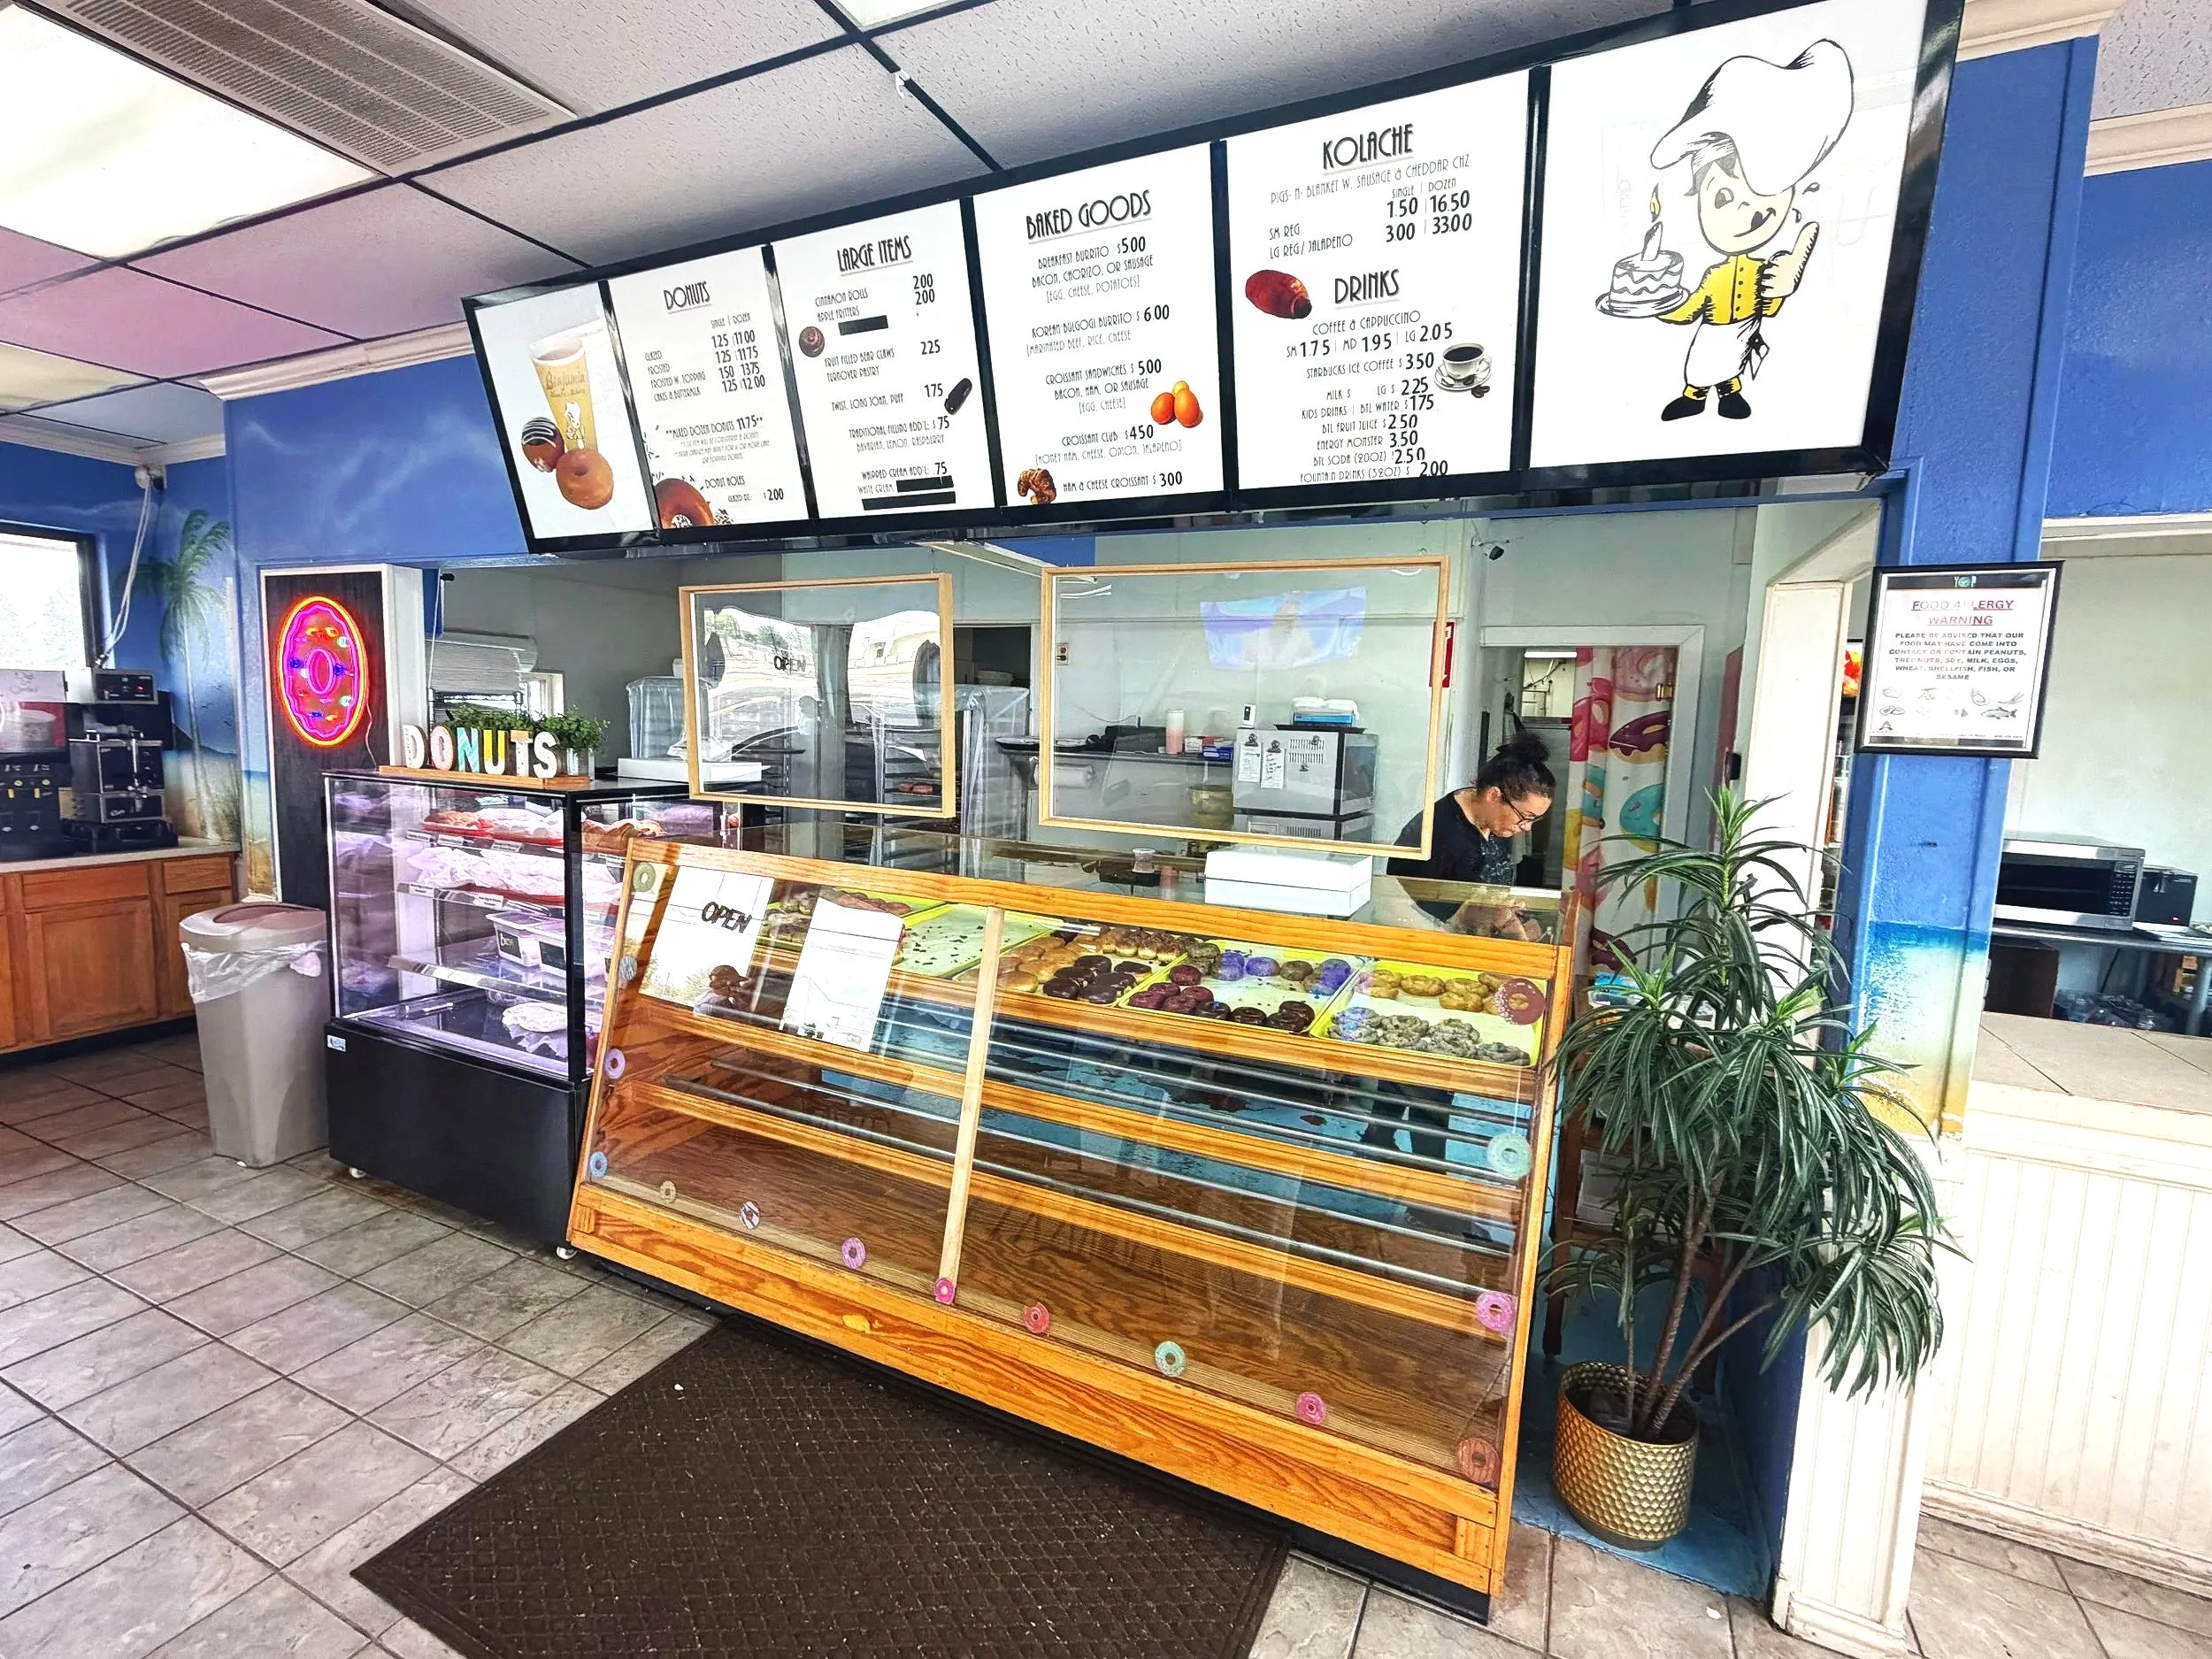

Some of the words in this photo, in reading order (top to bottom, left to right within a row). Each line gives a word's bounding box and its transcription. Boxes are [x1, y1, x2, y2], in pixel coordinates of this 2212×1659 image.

[1323, 123, 1413, 170] KOLACHE
[1306, 179, 1338, 197] BLANKET
[1356, 169, 1391, 188] SAUSAGE
[1394, 167, 1401, 180] &
[1405, 158, 1448, 177] CHEDDAR
[1452, 153, 1469, 168] CHZ
[1392, 185, 1414, 198] SINGLE
[1428, 177, 1455, 192] DOZEN
[1025, 208, 1072, 240] BAKED
[1078, 189, 1151, 227] GOODS
[1269, 227, 1280, 240] SM
[1284, 223, 1299, 237] REG
[1386, 196, 1417, 218] 1.50
[1430, 189, 1470, 212] 16.50
[1270, 246, 1279, 259] LG
[1386, 222, 1415, 242] 3.00
[836, 242, 875, 272] LARGE
[878, 234, 911, 264] ITEMS
[1038, 252, 1071, 269] BREAKFAST
[1075, 245, 1109, 262] BURRITO
[1032, 273, 1060, 288] BACON,
[1063, 265, 1103, 281] CHORIZO,
[1106, 261, 1120, 273] OR
[1124, 254, 1153, 270] SAUSAGE
[663, 280, 710, 311] DONUTS
[848, 288, 868, 301] ROLLS
[1334, 268, 1399, 303] DRINKS
[1032, 324, 1060, 338] KOREAN
[1063, 318, 1095, 333] BULGOGI
[1098, 311, 1132, 327] BURRITO
[1143, 304, 1169, 321] 6.00
[1312, 319, 1345, 335] COFFEE
[1349, 319, 1356, 330] &
[1359, 310, 1420, 329] CAPPUCCINO
[1108, 329, 1131, 342] CHEESE
[1286, 345, 1297, 357] SM
[1300, 339, 1330, 357] 1.75
[1342, 337, 1356, 350] MD
[1362, 332, 1391, 352] 1.95
[1405, 329, 1415, 342] LG
[1419, 321, 1452, 342] 2.05
[876, 347, 895, 359] CLAWS
[859, 365, 879, 377] PASTRY
[1045, 370, 1082, 385] CROISSANT
[1085, 364, 1126, 380] SANDWICHES
[1306, 364, 1345, 378] STARBUCKS
[1348, 362, 1360, 373] ICE
[1363, 358, 1393, 372] COFFEE
[1405, 351, 1434, 370] 3.50
[1104, 381, 1118, 393] OR
[1120, 377, 1148, 391] SAUSAGE
[1326, 389, 1342, 400] MILK
[1377, 384, 1386, 396] LG
[1302, 408, 1317, 419] KIDS
[1321, 405, 1347, 418] DRINKS
[1360, 403, 1371, 413] BTL
[1375, 400, 1399, 411] WATER
[1322, 423, 1333, 434] BTL
[1336, 421, 1355, 432] FRUIT
[1358, 419, 1377, 430] JUICE
[1061, 433, 1098, 446] CROISSANT
[1101, 431, 1118, 442] CLUB
[1317, 438, 1343, 449] ENERGY
[1347, 435, 1383, 447] MONSTER
[1389, 429, 1417, 448] 3.50
[1313, 456, 1324, 466] BTL
[1327, 454, 1350, 465] SODA
[1063, 482, 1077, 492] HAM
[1087, 479, 1108, 490] CHEESE
[1110, 475, 1148, 488] CROISSANT
[1300, 472, 1335, 482] FOUNTAIN
[1339, 469, 1364, 480] DRINKS
[1913, 601, 1949, 610] FOOD
[1955, 600, 2014, 610] ALERGY
[1929, 616, 1993, 625] WARNING
[403, 725, 558, 779] DONUTS
[701, 901, 752, 933] OPEN
